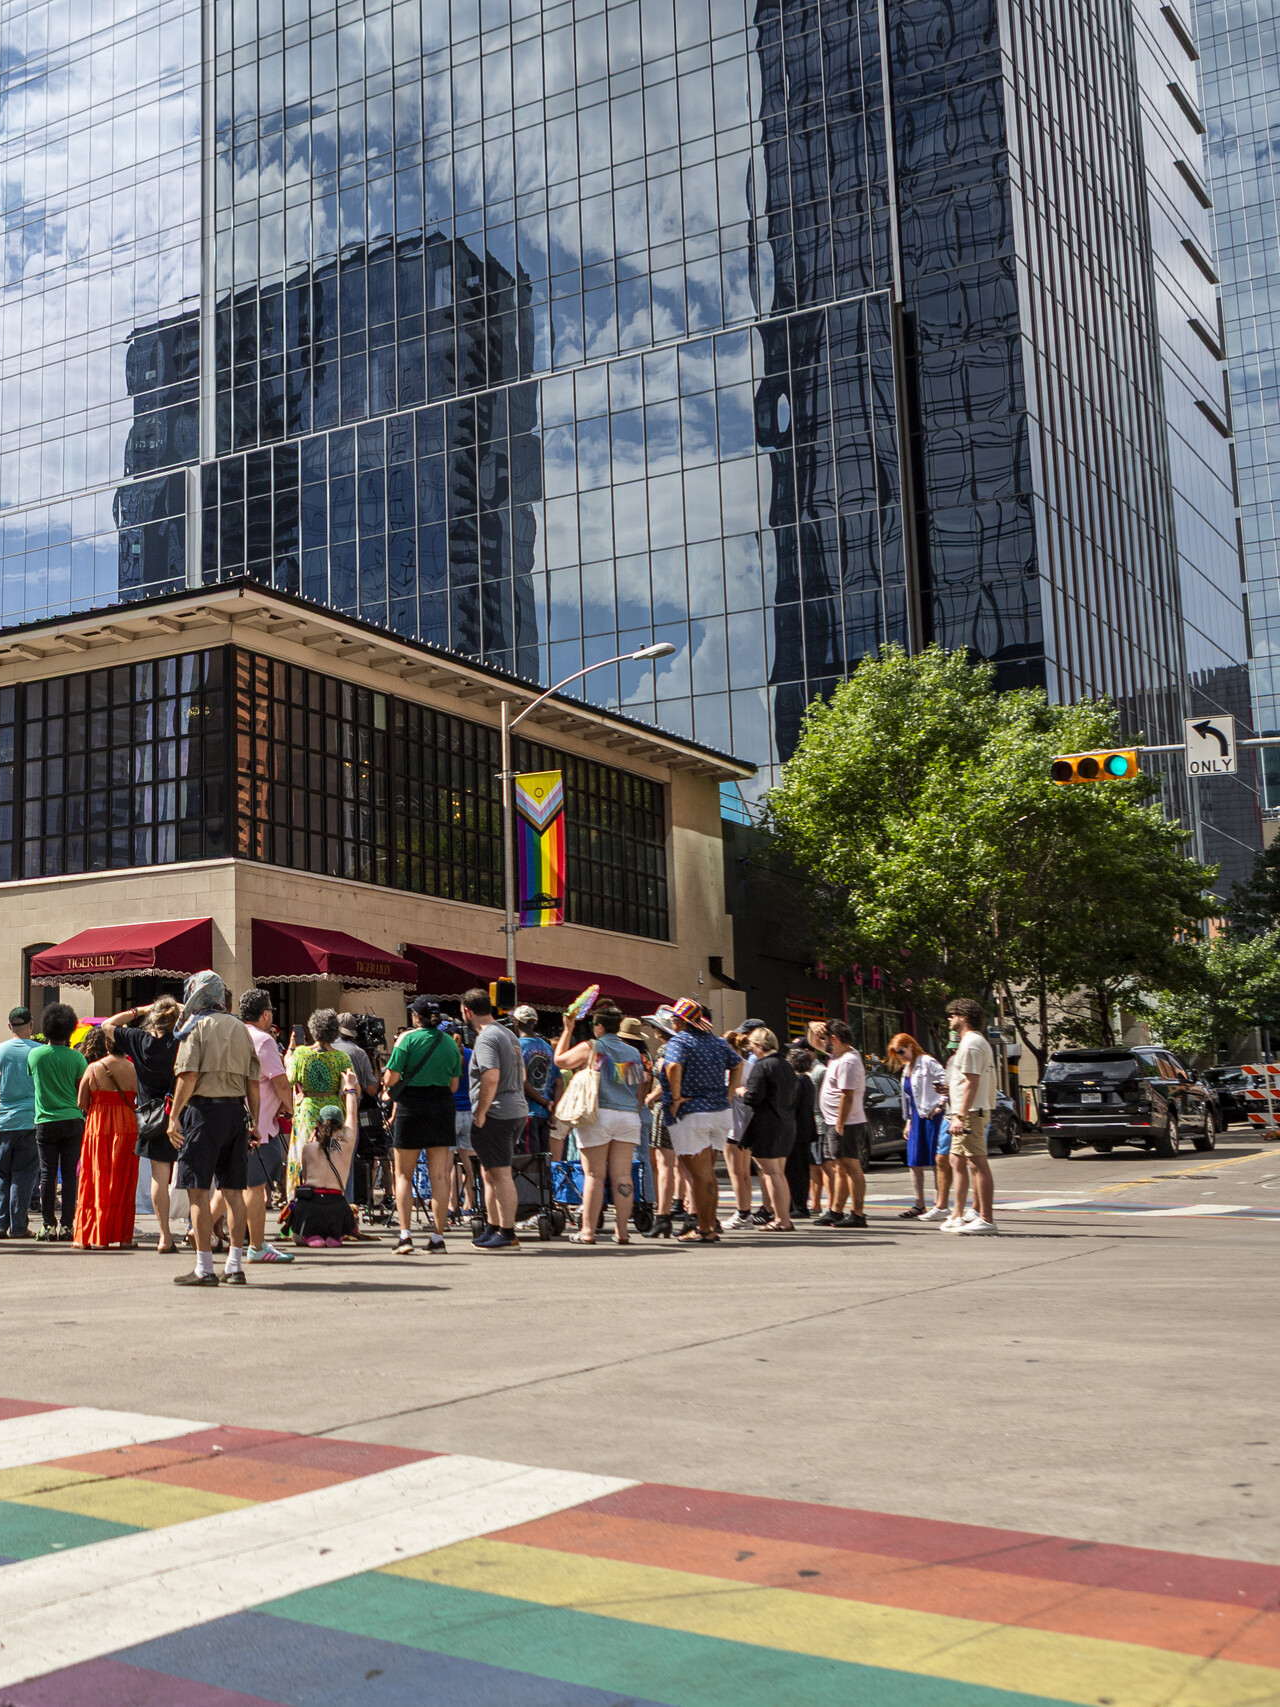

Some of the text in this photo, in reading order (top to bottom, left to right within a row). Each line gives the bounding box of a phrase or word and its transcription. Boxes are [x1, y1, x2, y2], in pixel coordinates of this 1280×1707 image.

[1190, 758, 1232, 774] ONLY
[67, 955, 116, 969] TIGER LILLY
[356, 961, 390, 975] TIGER LILLY
